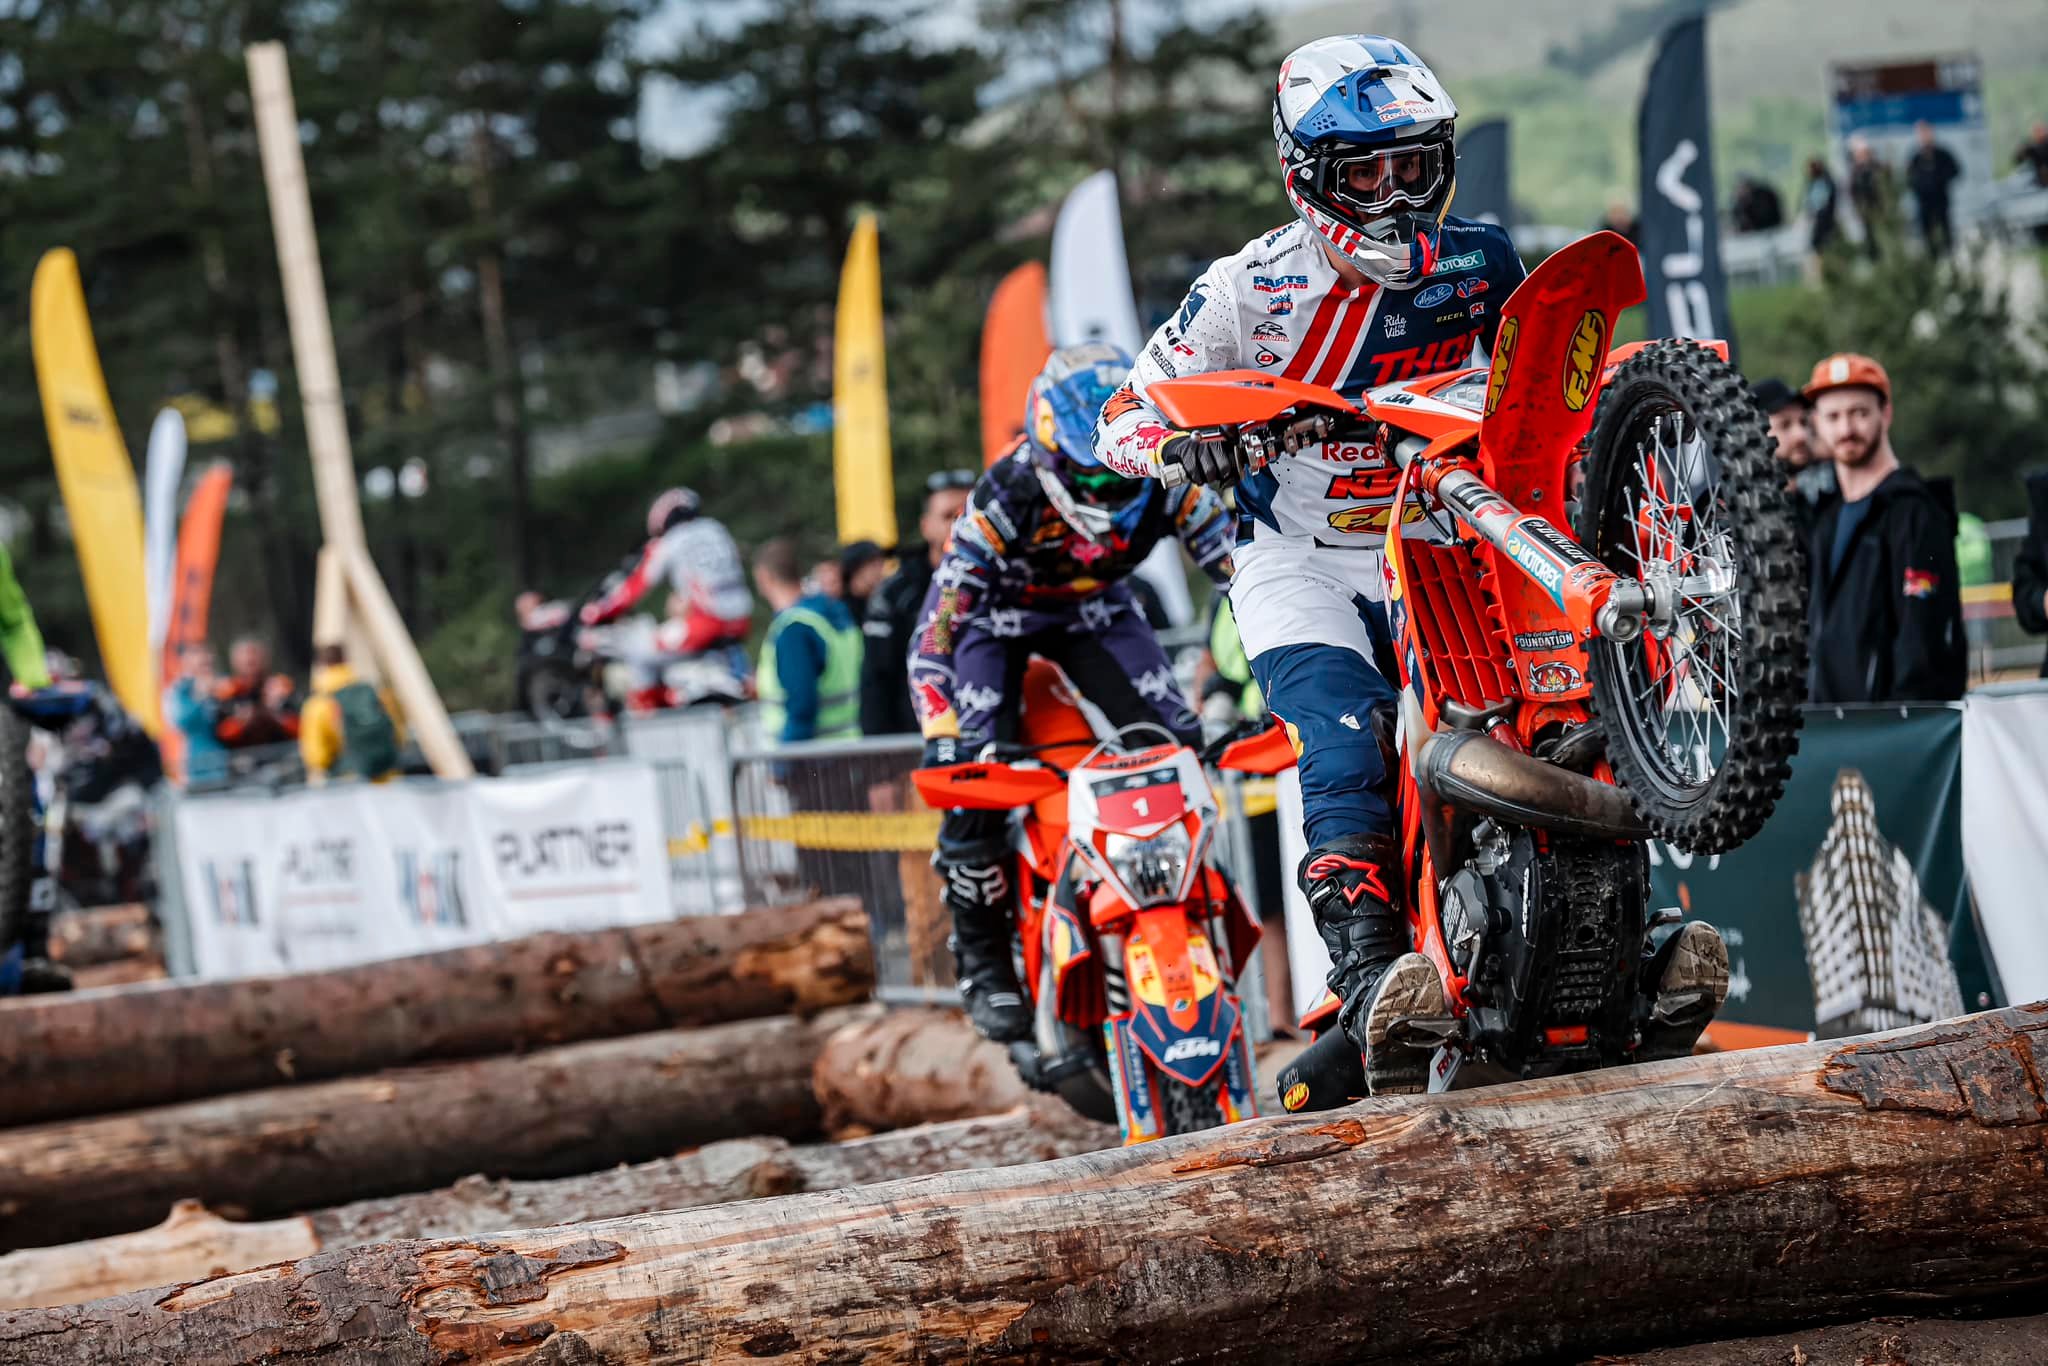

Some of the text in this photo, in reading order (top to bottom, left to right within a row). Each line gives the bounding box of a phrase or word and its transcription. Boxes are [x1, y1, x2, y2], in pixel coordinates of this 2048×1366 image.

[1253, 275, 1309, 288] PARTS
[1253, 283, 1309, 293] UNLIMITED
[1384, 313, 1407, 328] Ride
[1436, 312, 1465, 323] EXCEL
[1385, 325, 1407, 339] Vibe
[1564, 310, 1606, 411] FMF
[1540, 522, 1591, 562] DUNLOP
[1517, 543, 1562, 592] MOTOREX
[1515, 632, 1573, 647] FOUNDATION
[951, 769, 989, 783] KTM
[1132, 796, 1149, 817] 1
[1163, 1036, 1220, 1063] KTM
[1283, 1081, 1310, 1111] FMF
